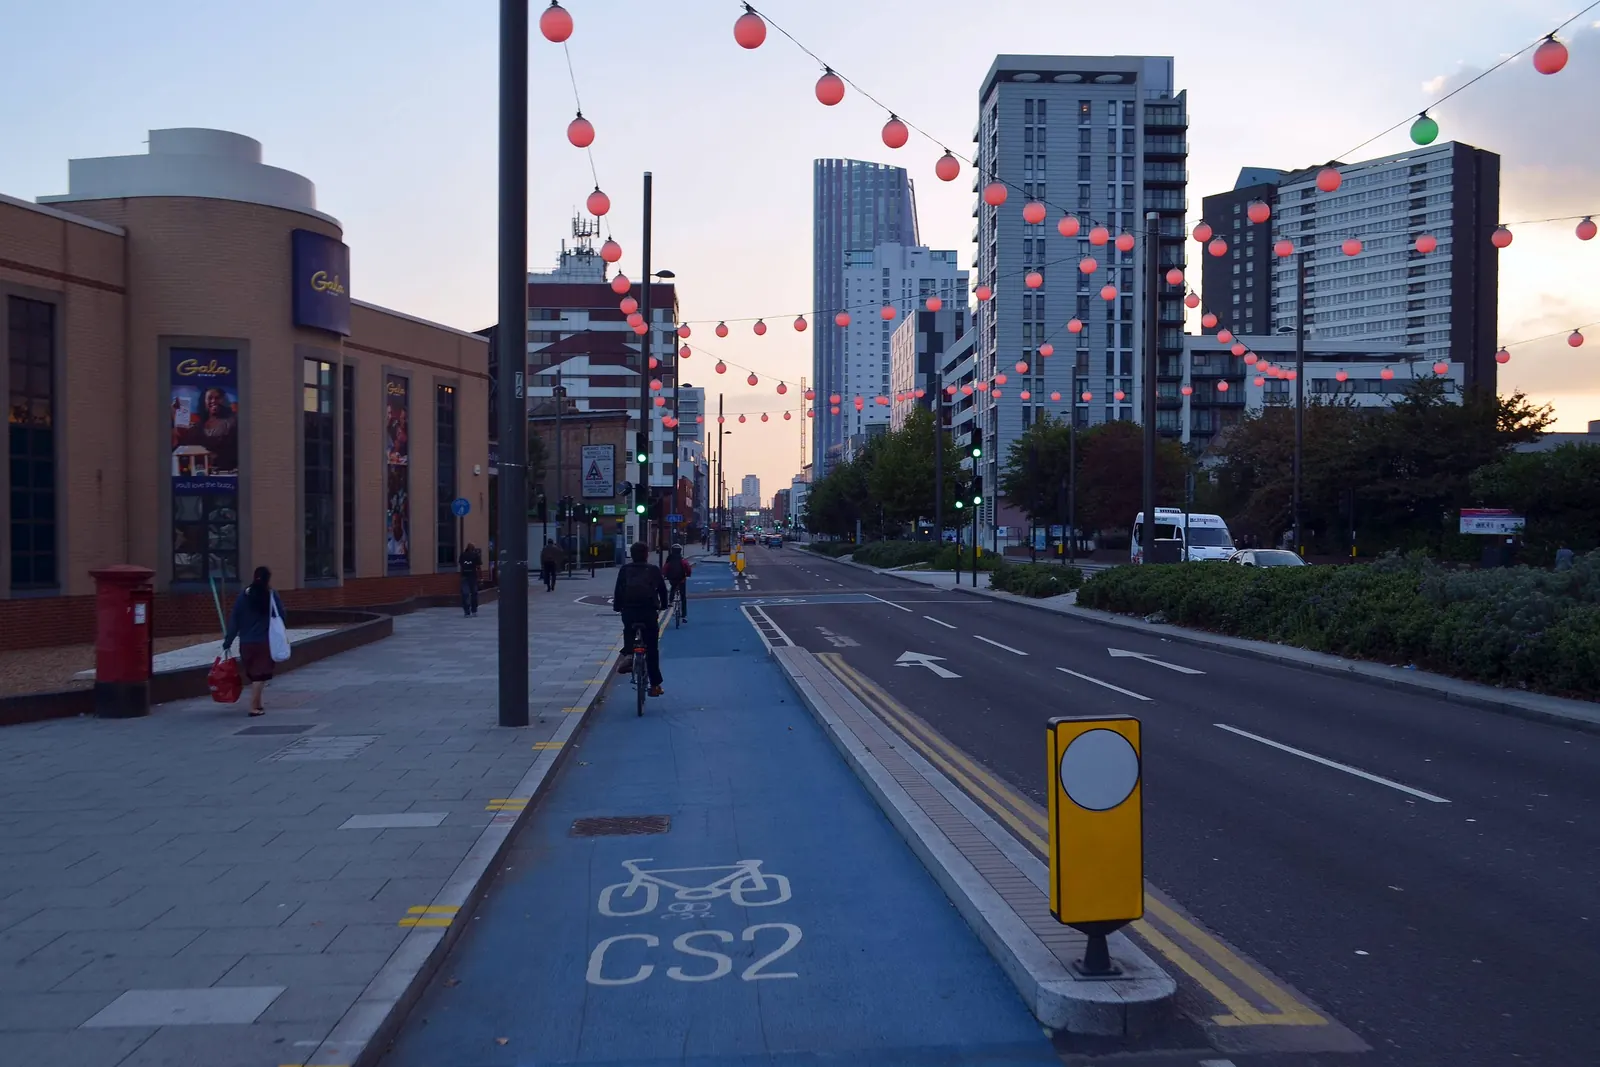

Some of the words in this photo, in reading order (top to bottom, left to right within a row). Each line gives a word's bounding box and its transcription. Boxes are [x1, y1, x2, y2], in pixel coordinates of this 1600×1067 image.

[311, 270, 345, 294] Gala
[176, 359, 231, 376] Gala
[586, 922, 803, 985] CS2
